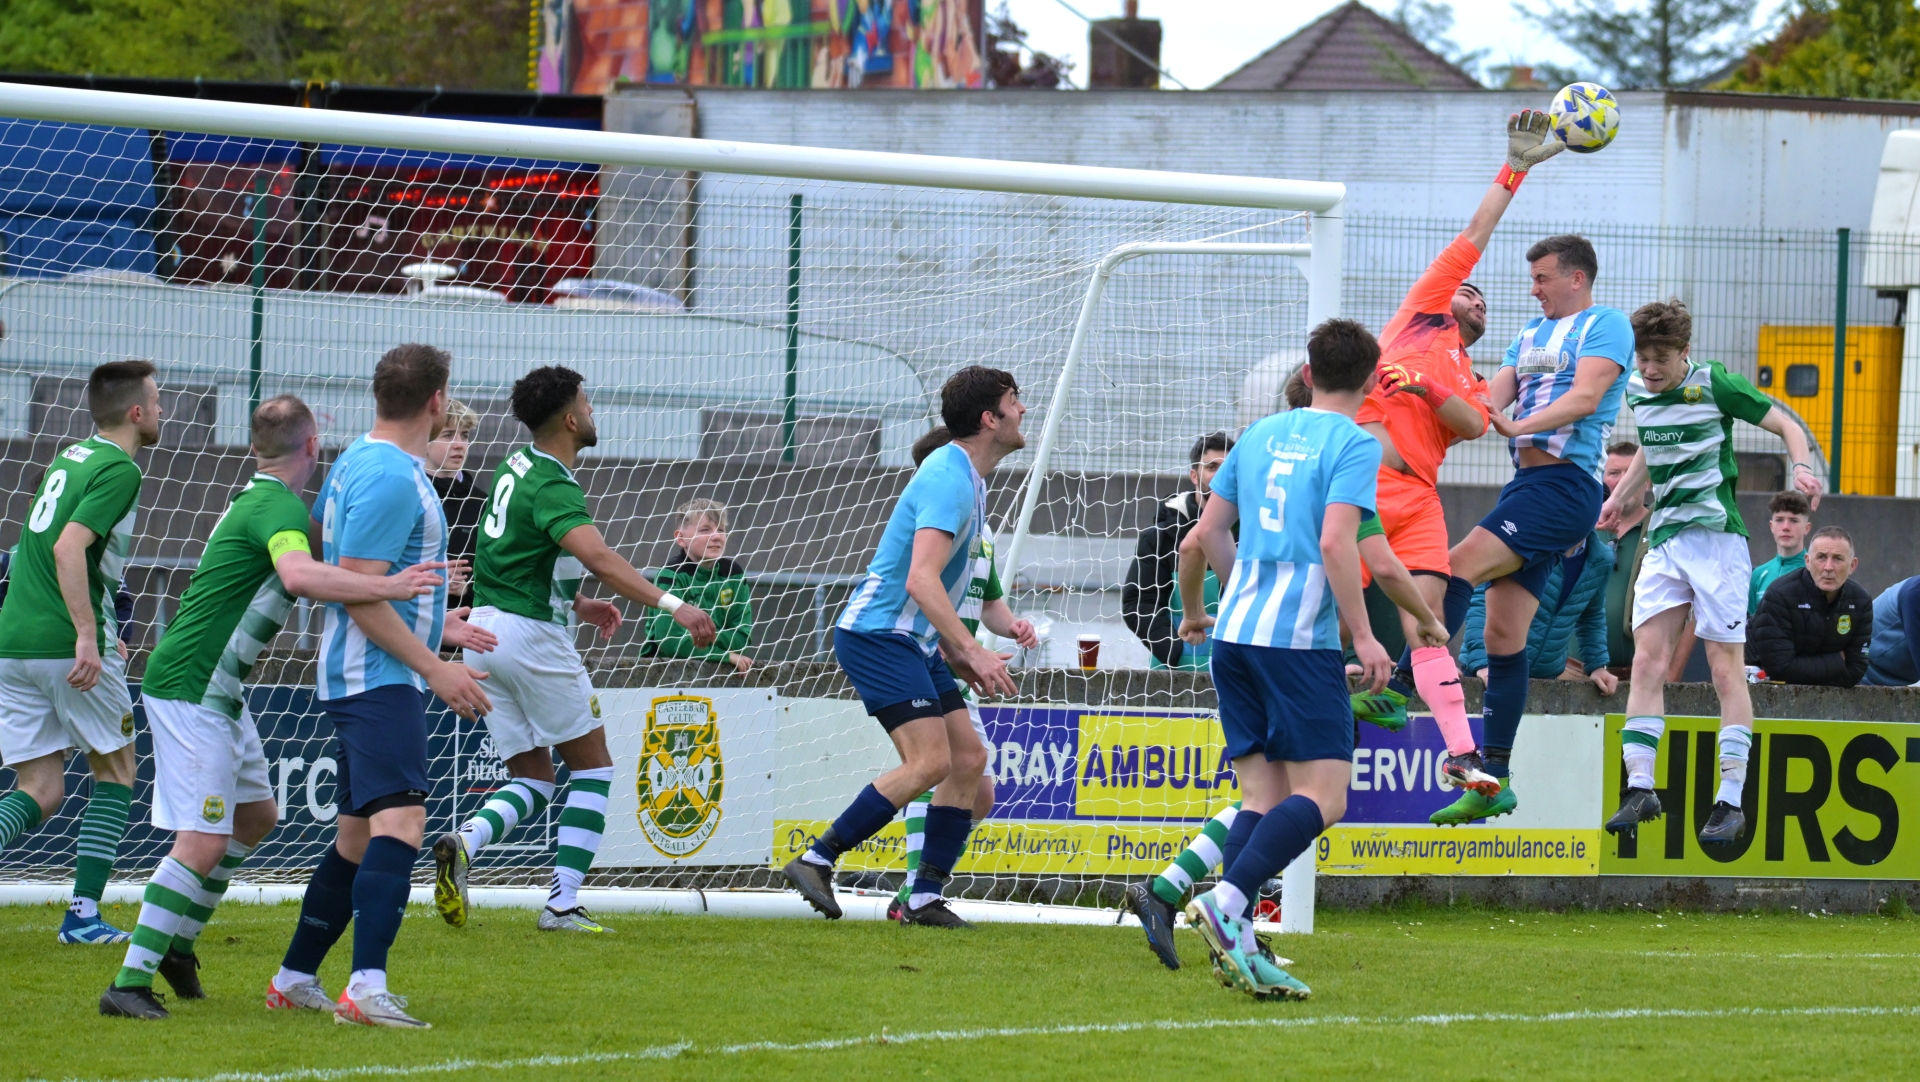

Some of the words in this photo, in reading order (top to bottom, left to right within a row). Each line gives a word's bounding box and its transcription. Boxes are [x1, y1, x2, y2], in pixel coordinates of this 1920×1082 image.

[1643, 430, 1685, 443] Albany
[28, 468, 68, 534] 8
[484, 473, 516, 539] 9
[1259, 459, 1294, 533] 5
[657, 702, 705, 714] CASTLEBAR
[667, 713, 697, 723] CELTIC
[1081, 743, 1238, 790] AMBULA
[1350, 748, 1455, 792] ERVIC
[1618, 729, 1920, 866] HURS
[644, 819, 688, 851] FOOTBALL
[691, 821, 713, 847] CLUB
[971, 828, 1000, 859] for
[1005, 830, 1084, 863] Murray.
[1351, 834, 1586, 864] www.murrayambulance.ie
